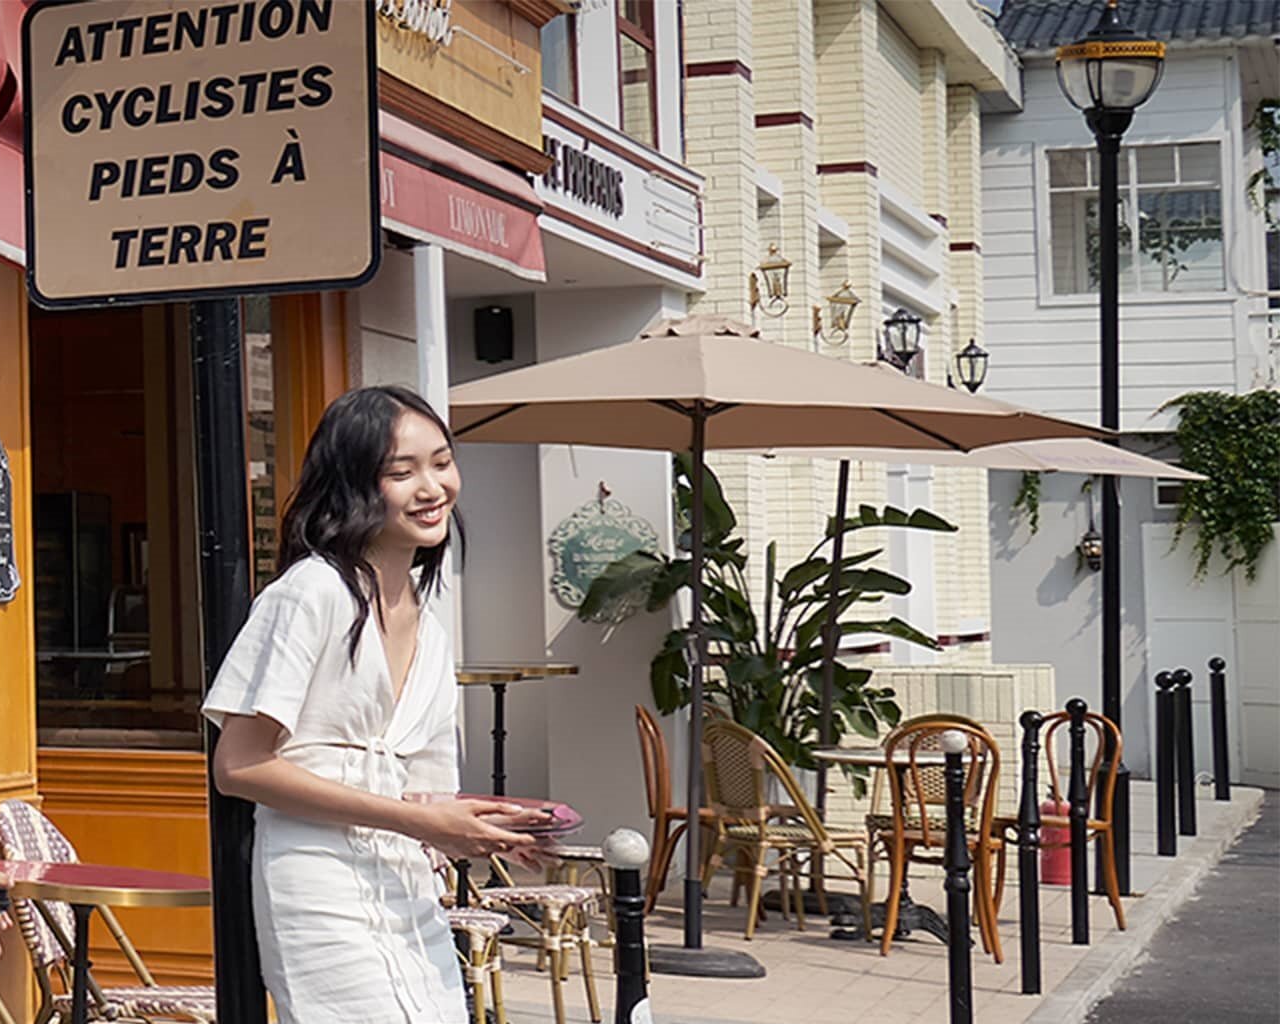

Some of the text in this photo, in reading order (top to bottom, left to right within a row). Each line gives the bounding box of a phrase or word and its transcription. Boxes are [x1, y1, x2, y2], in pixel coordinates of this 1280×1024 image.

[54, 0, 333, 67] ATTENTION
[61, 65, 334, 134] CYCLISTES
[88, 129, 307, 201] PIEDS À
[111, 218, 271, 269] TERRE
